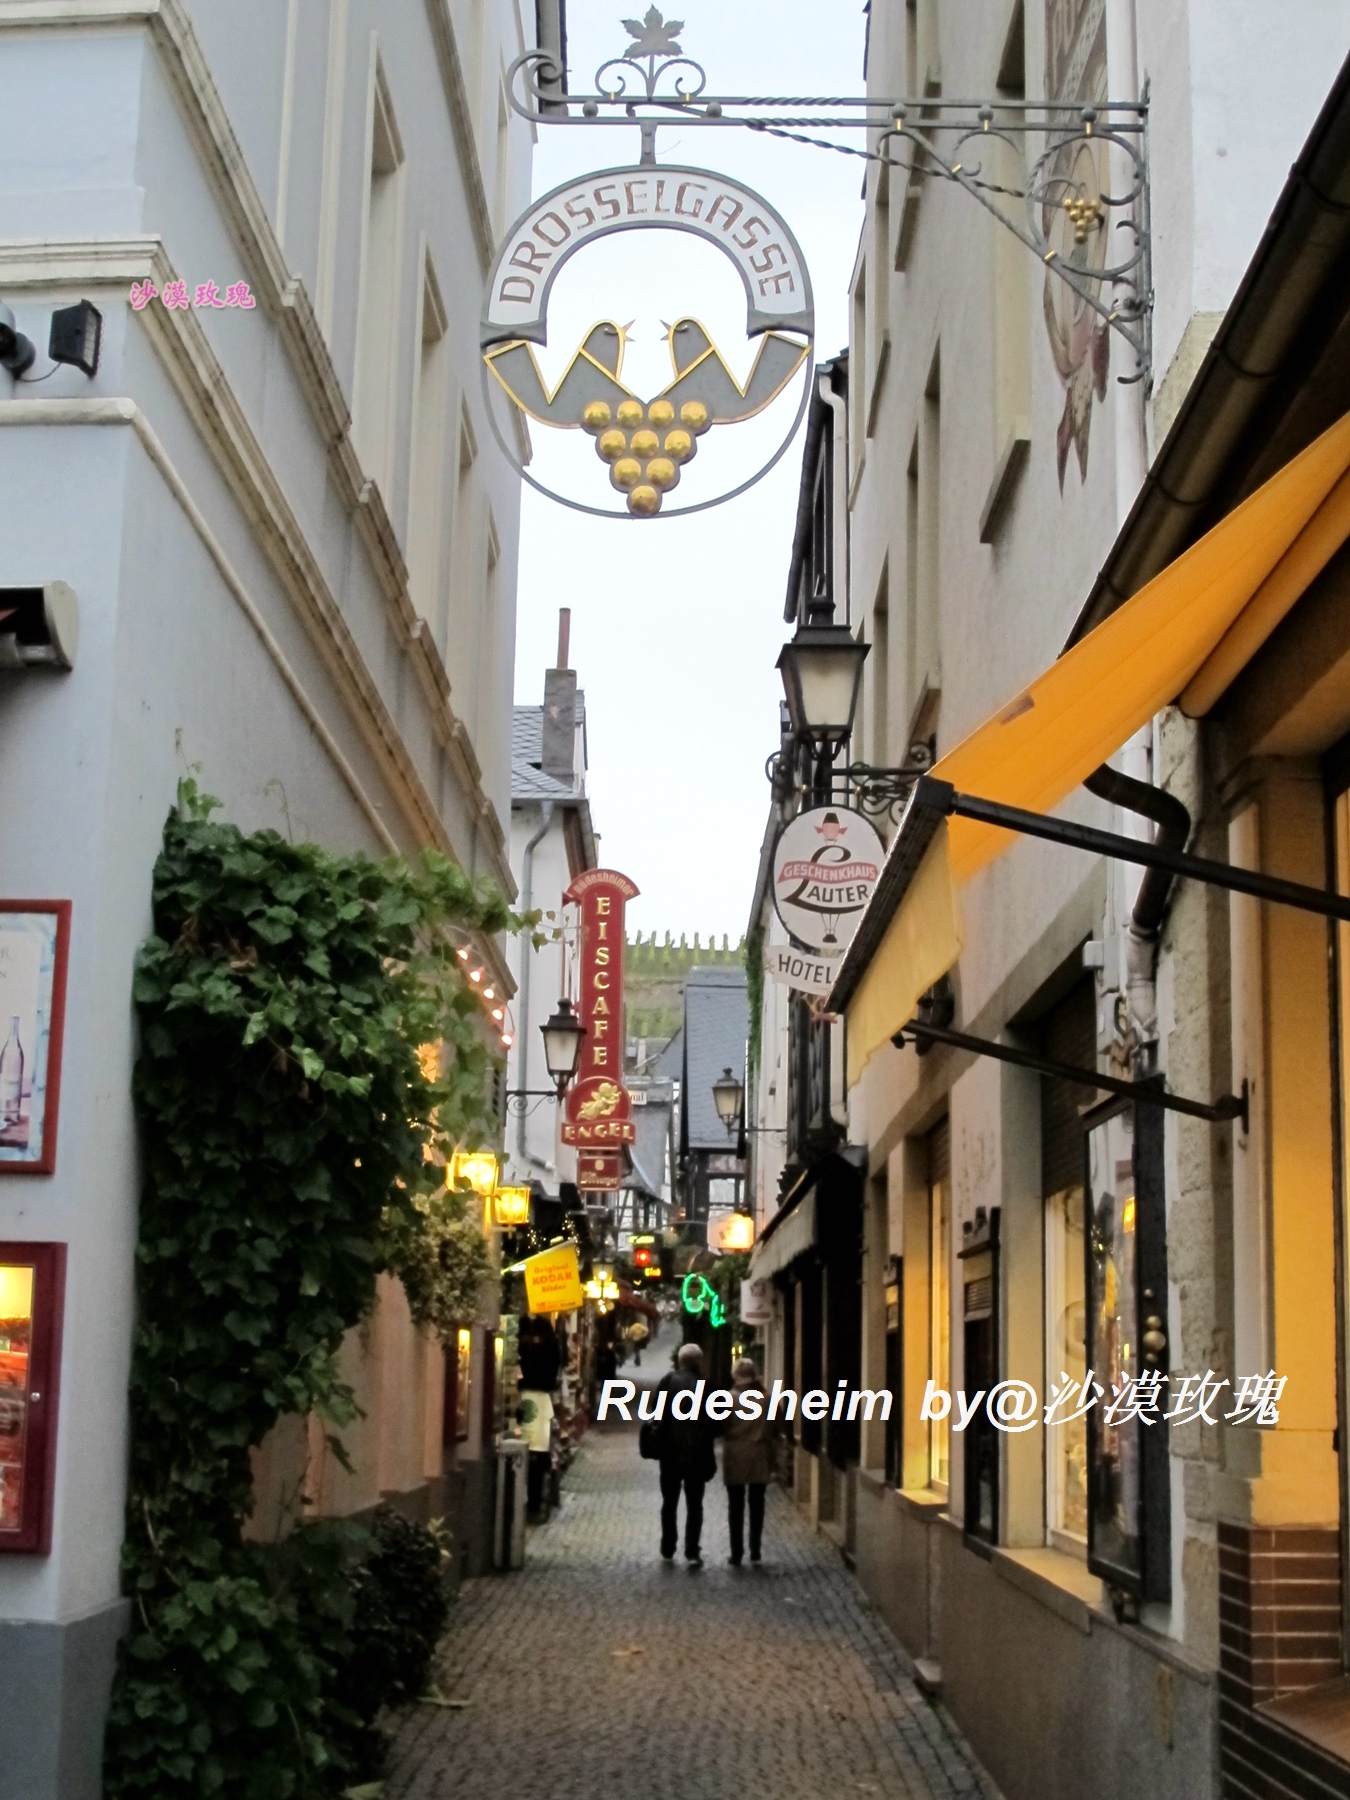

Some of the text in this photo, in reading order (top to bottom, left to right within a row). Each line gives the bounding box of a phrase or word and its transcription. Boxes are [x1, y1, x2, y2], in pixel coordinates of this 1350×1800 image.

[499, 179, 796, 304] DROSSELGASSE
[784, 862, 877, 882] GESCHENKHAUS
[778, 953, 833, 985] HOTEL
[564, 1122, 634, 1140] ENGEL
[532, 1272, 572, 1285] KODAK
